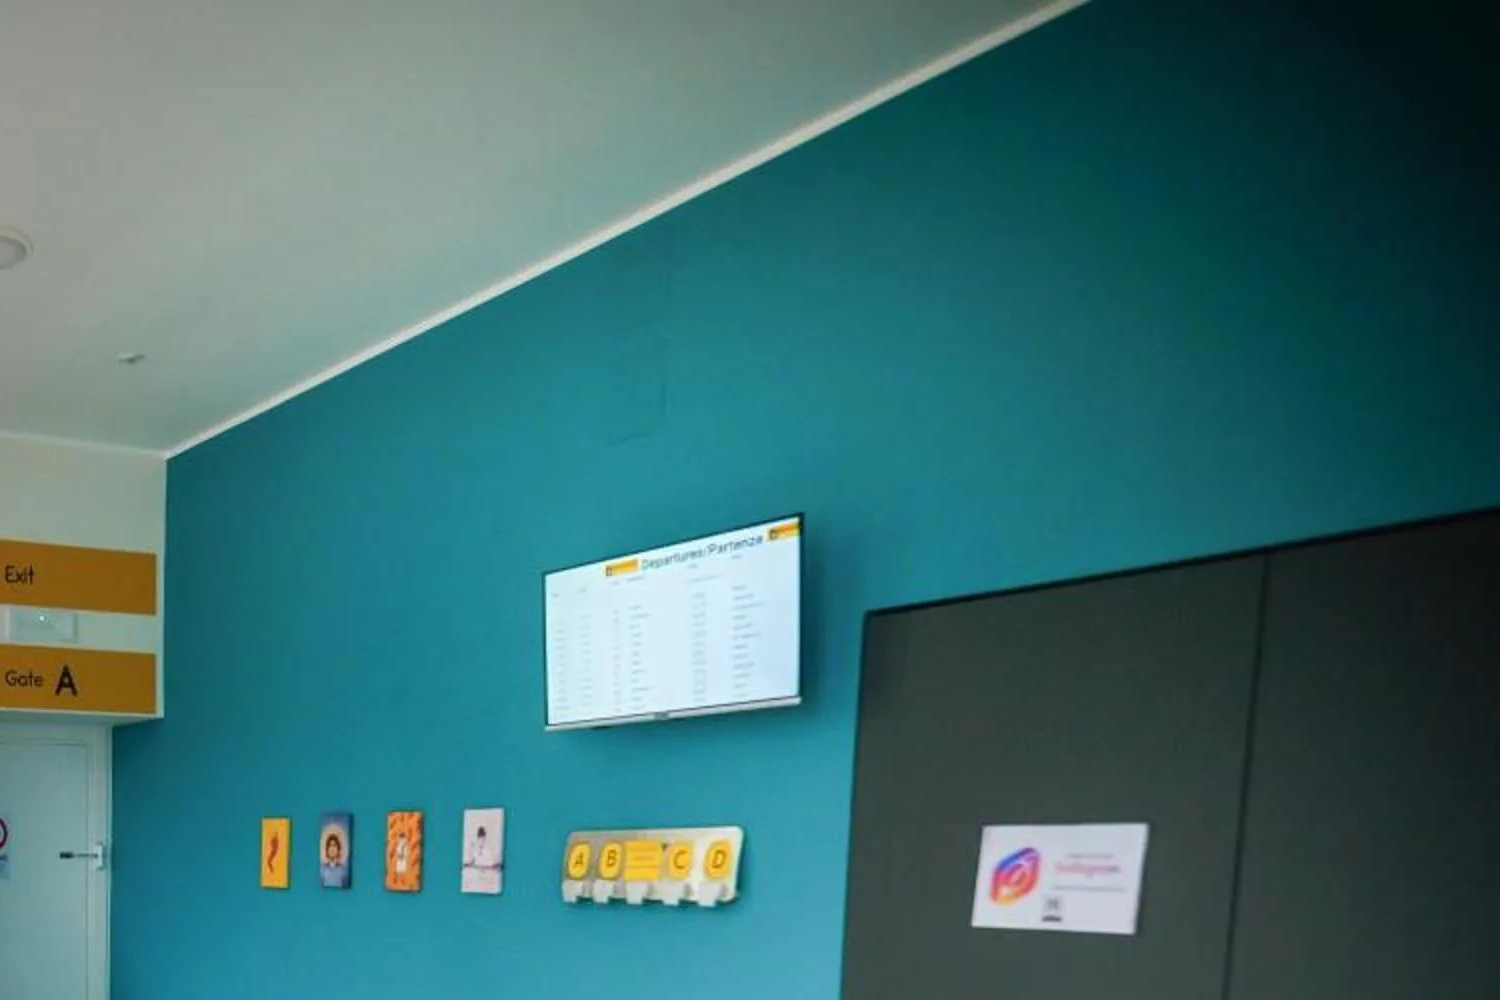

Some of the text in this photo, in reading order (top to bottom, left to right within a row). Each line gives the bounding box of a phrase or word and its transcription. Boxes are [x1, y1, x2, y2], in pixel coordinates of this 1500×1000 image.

[4, 564, 36, 585] Exit
[4, 665, 78, 697] Gate A
